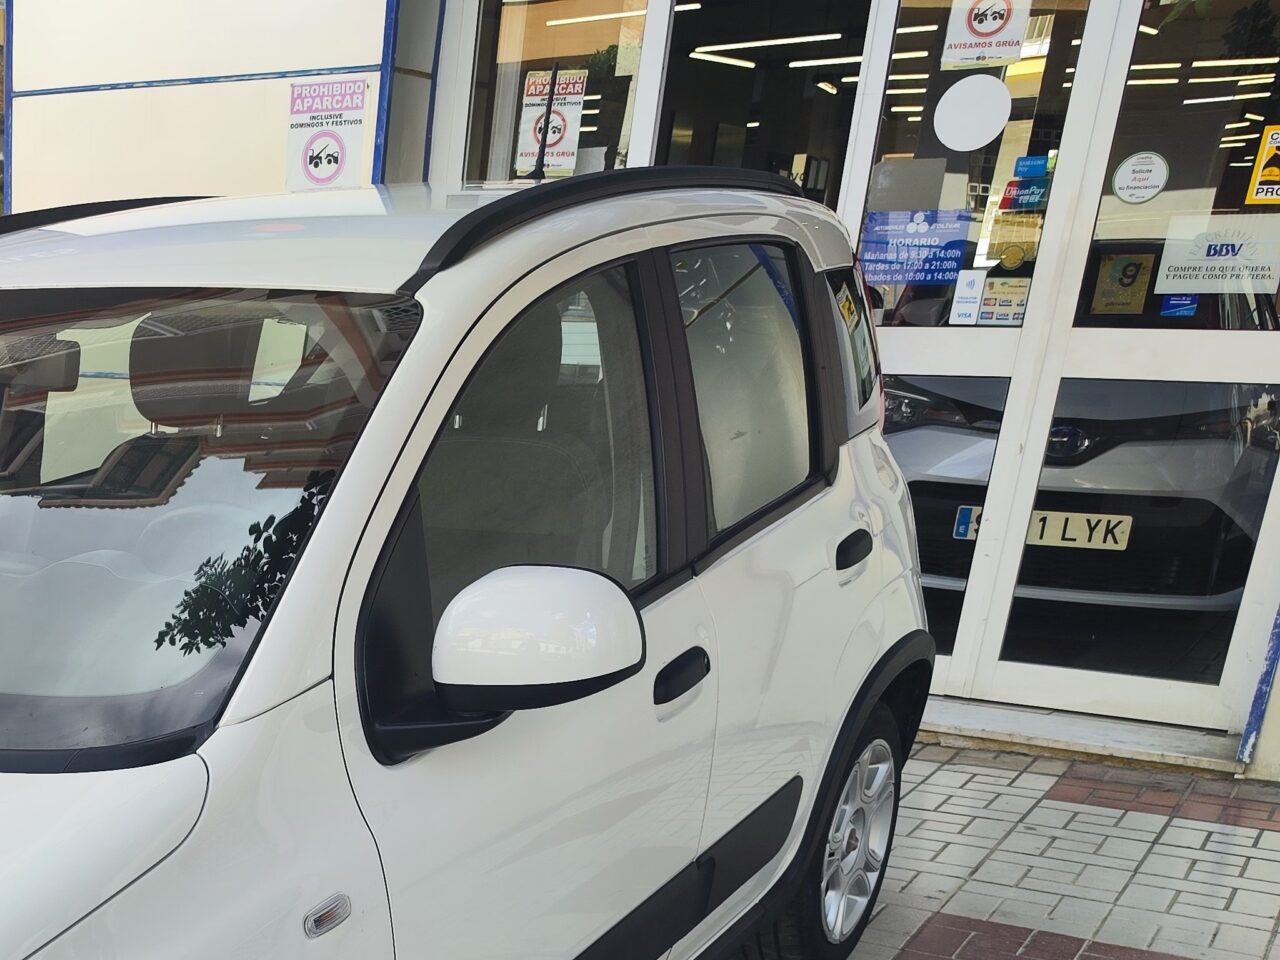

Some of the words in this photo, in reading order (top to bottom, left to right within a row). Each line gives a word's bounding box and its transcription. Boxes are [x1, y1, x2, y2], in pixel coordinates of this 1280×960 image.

[947, 41, 992, 50] AVISAMOS
[995, 38, 1020, 47] GRÚA
[528, 75, 584, 85] PROIBIDO
[293, 81, 364, 98] PROHIBIDO
[293, 94, 363, 112] APARCAR
[309, 113, 343, 121] INCLUSIVE
[888, 237, 939, 247] HORARIO
[863, 252, 897, 260] Mañanas
[899, 251, 908, 259] de
[935, 249, 961, 258] 14:00h
[1205, 243, 1244, 257] BBV
[864, 262, 889, 270] Tardes
[891, 262, 901, 270] de
[903, 262, 923, 270] 17:00
[931, 261, 957, 269] 21:00h
[1167, 265, 1204, 273] COMPRE
[1205, 265, 1216, 273] LO
[1218, 265, 1236, 273] QUE
[893, 272, 902, 280] de
[905, 272, 925, 280] 10:00
[933, 271, 959, 280] 14:00h
[1061, 517, 1124, 545] LYK
